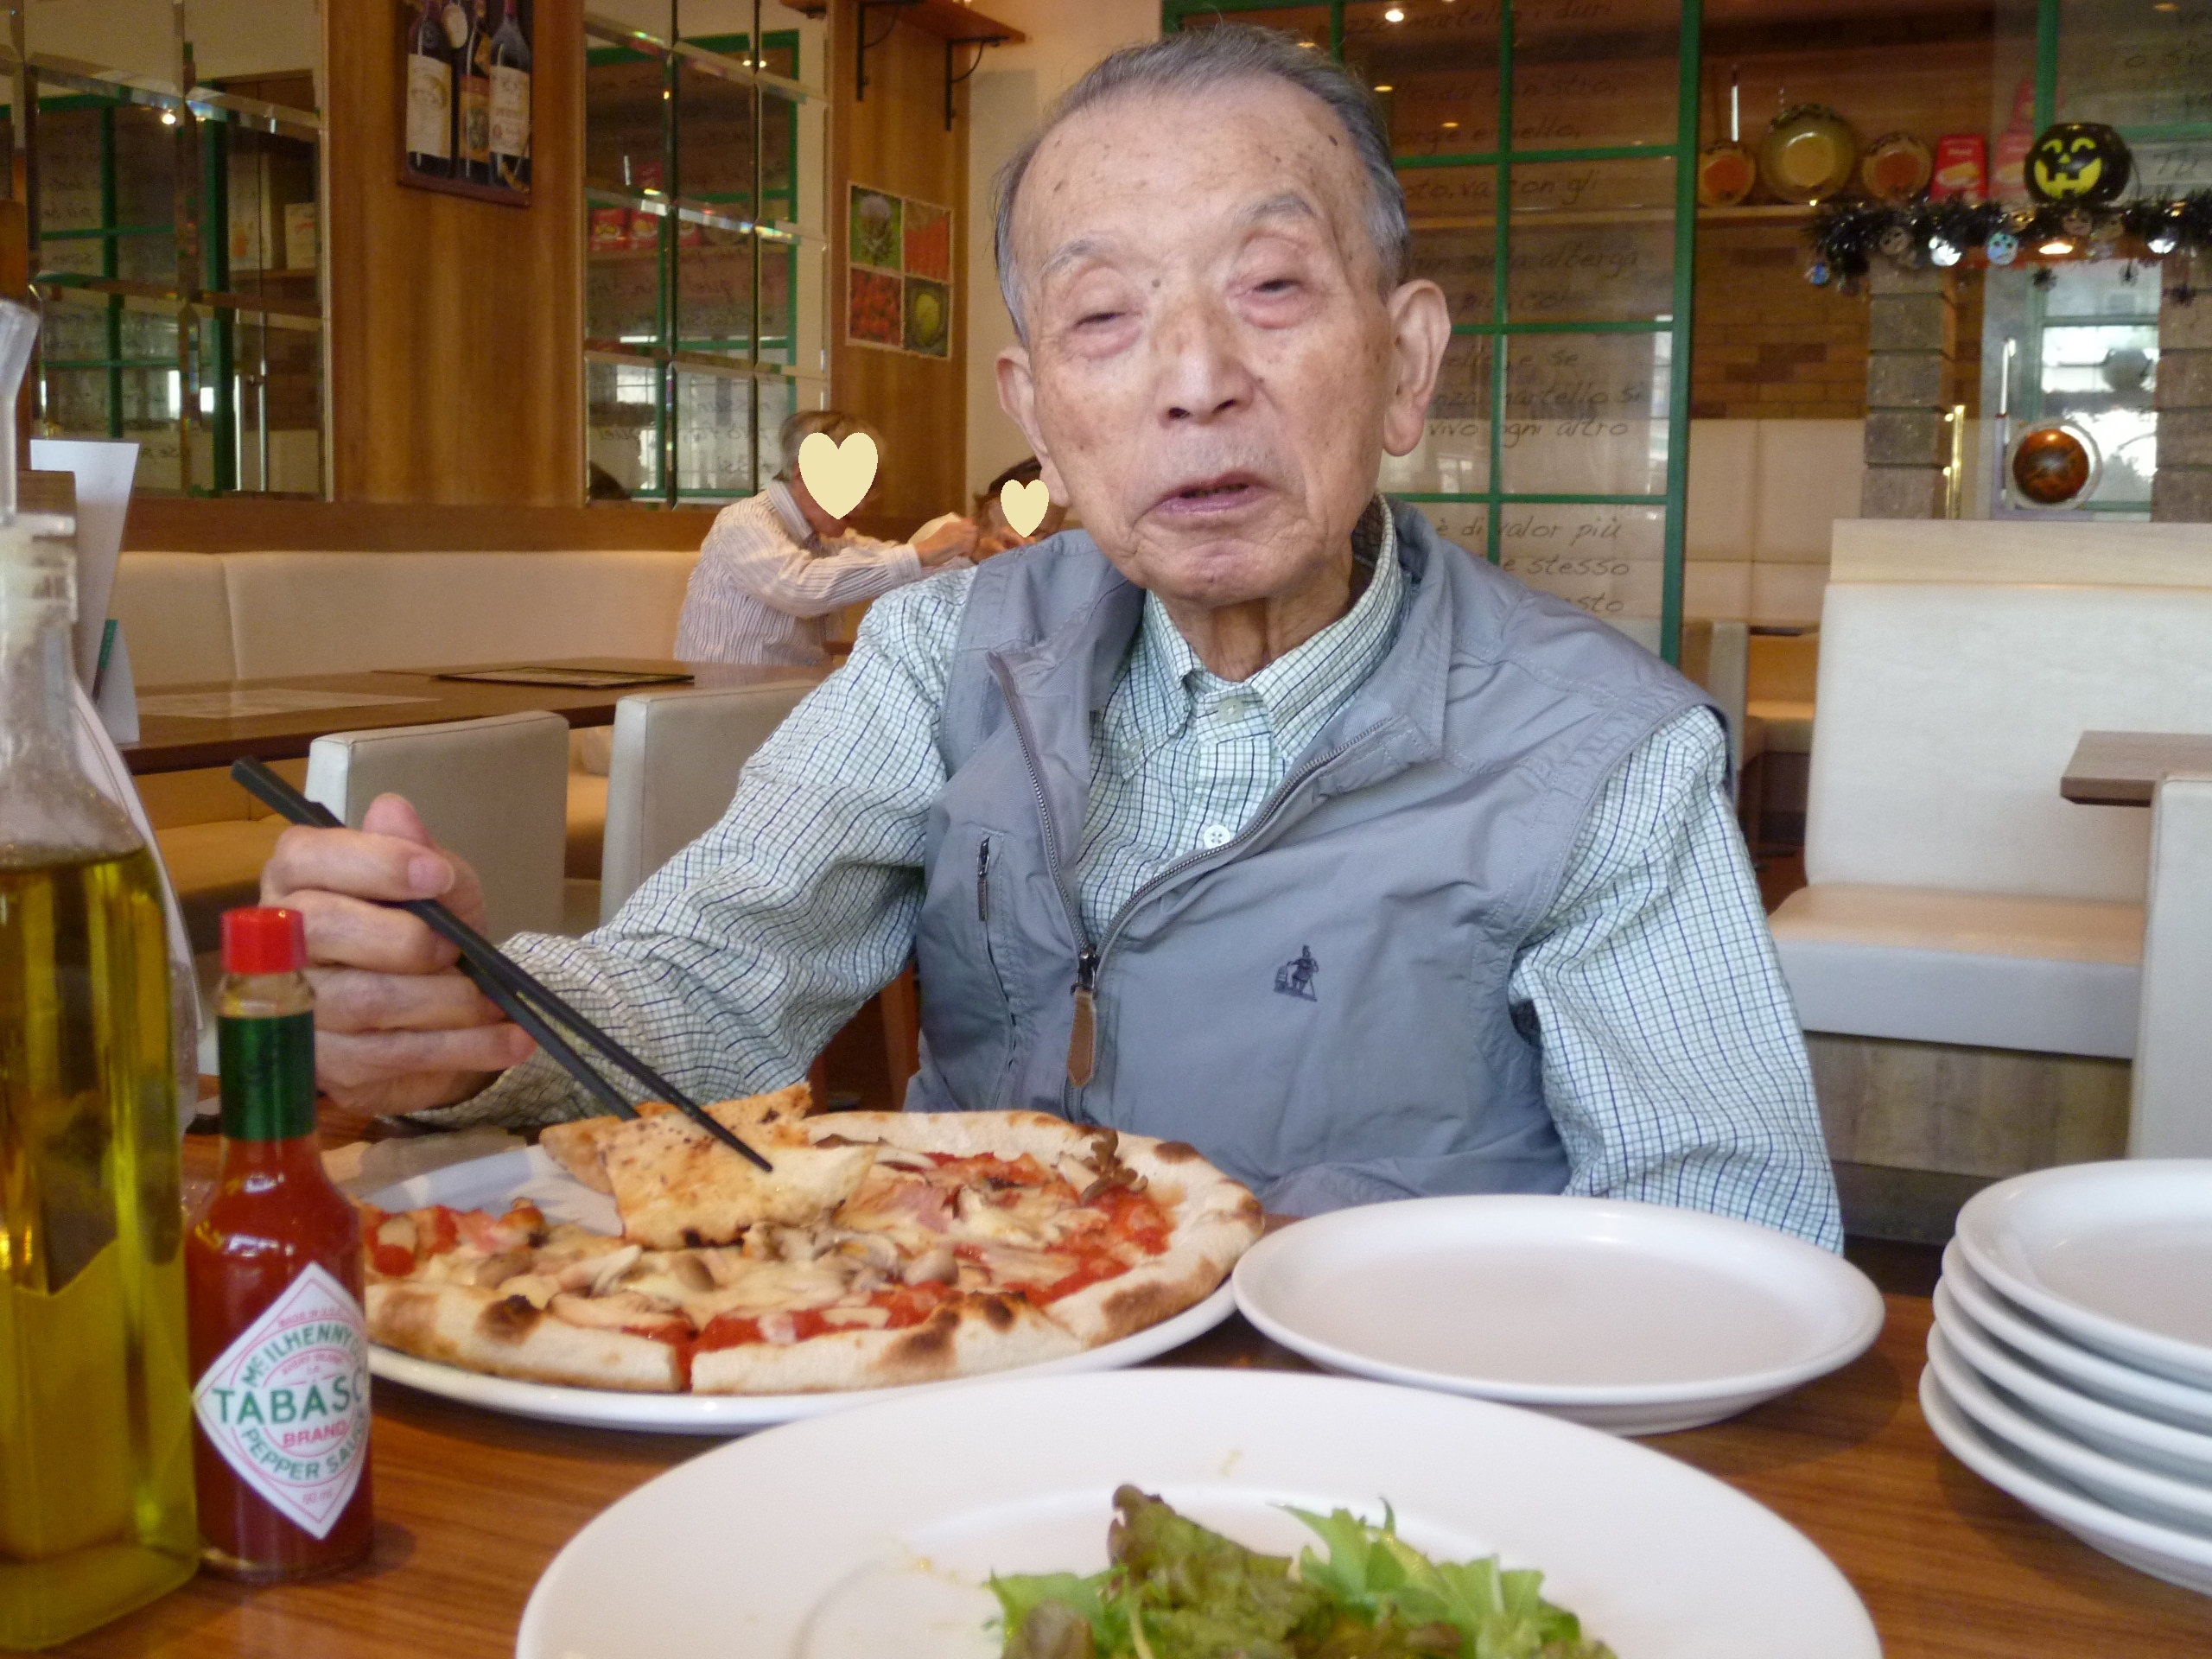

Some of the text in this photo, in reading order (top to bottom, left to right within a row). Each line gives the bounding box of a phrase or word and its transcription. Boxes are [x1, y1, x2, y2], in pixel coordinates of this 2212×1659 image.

[1556, 414, 1629, 437] altro
[1526, 554, 1630, 576] stesso
[212, 1360, 368, 1425] TABASC
[283, 1420, 349, 1448] BRAND
[241, 1427, 320, 1481] PEPPER
